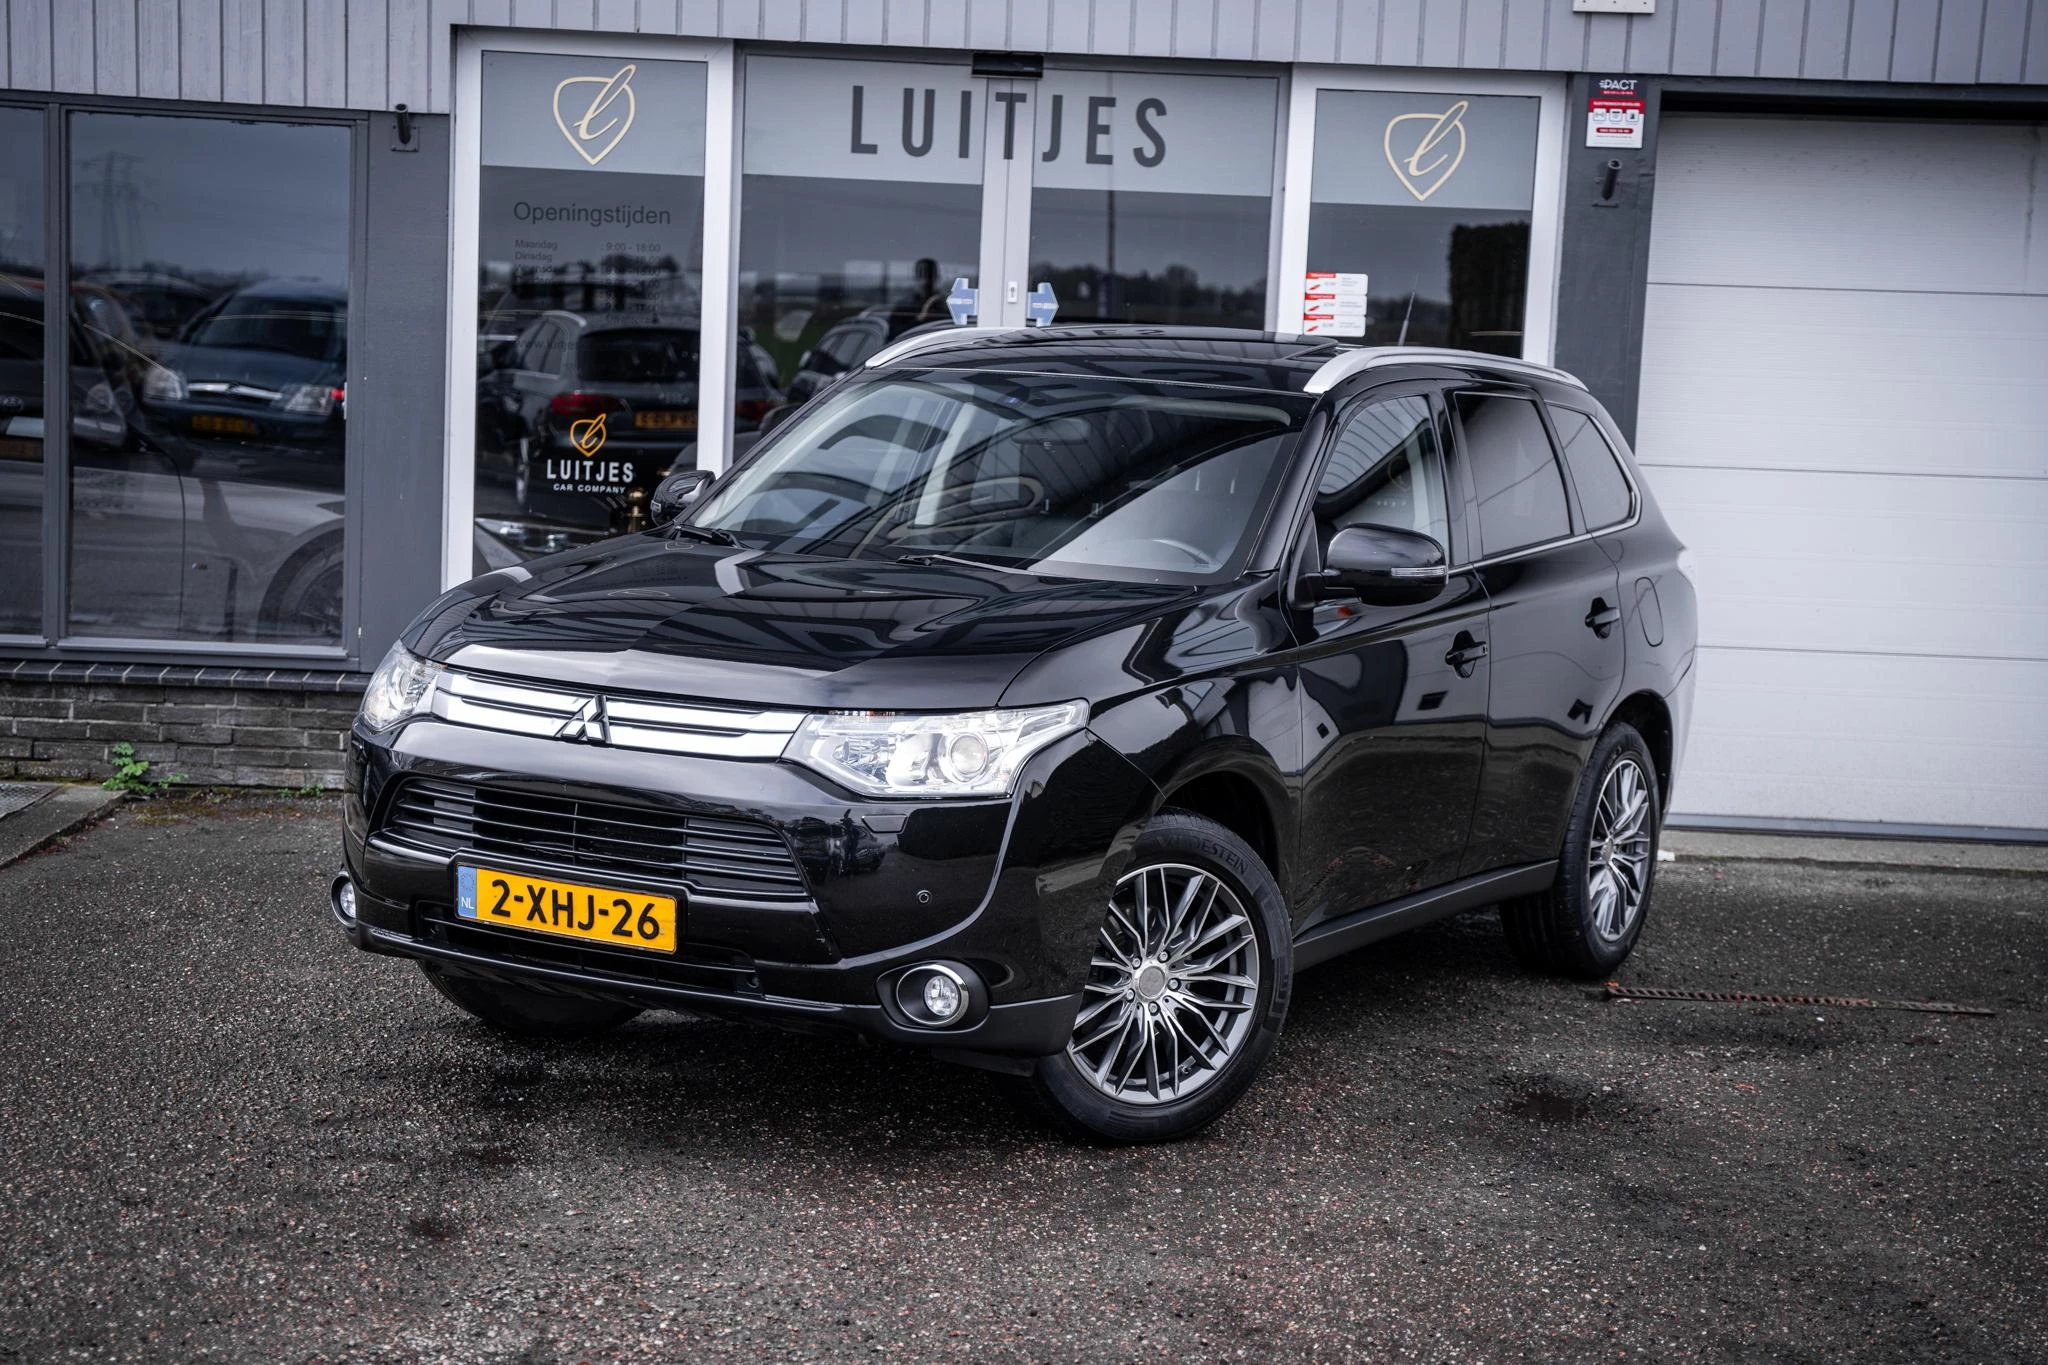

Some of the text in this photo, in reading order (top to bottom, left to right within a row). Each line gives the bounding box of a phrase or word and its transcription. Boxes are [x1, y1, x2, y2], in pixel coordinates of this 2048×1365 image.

[850, 85, 1168, 168] LUITJES
[513, 201, 671, 228] Openingstijden
[546, 459, 634, 484] LUITJES
[553, 483, 626, 494] CAR COMPANY
[461, 896, 475, 910] NL
[490, 879, 661, 941] 2-XHJ-26
